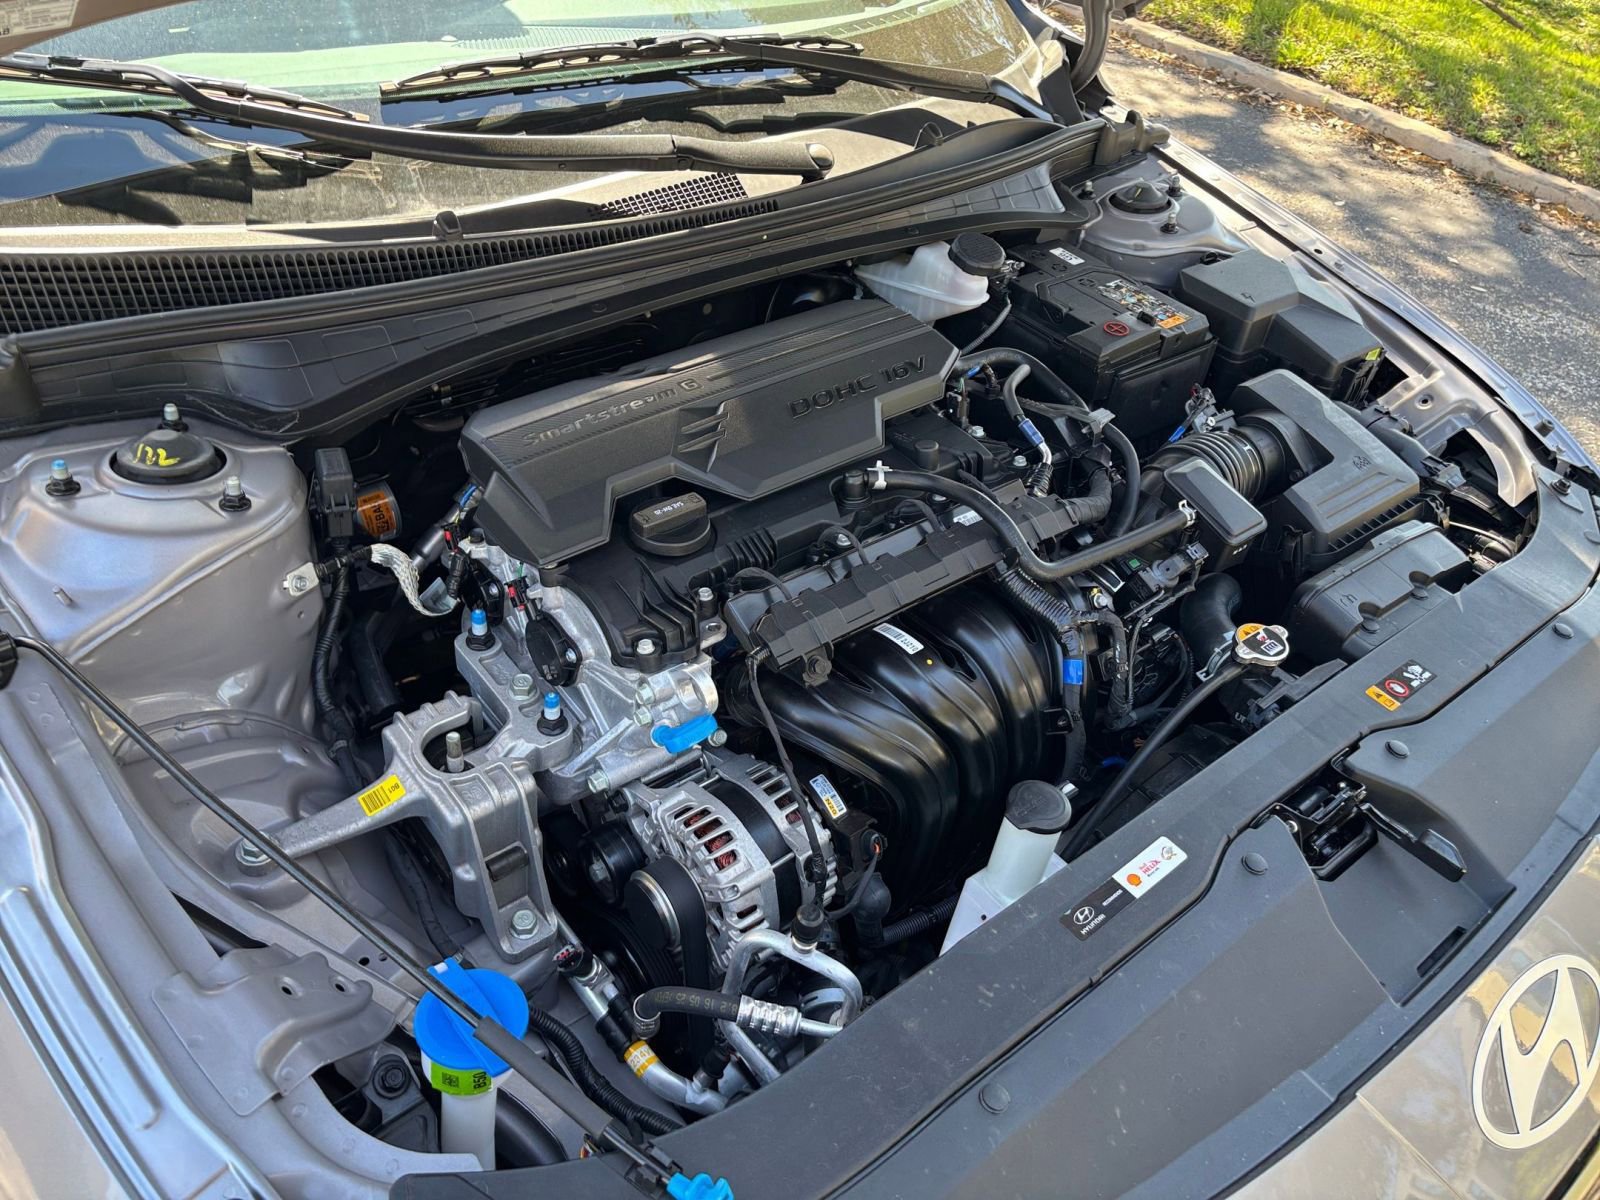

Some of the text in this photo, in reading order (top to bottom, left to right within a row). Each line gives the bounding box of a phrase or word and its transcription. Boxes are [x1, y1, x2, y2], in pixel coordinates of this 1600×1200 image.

[788, 355, 926, 418] DOHC 16V
[522, 379, 699, 446] Smartstream G
[387, 782, 400, 794] B01
[1080, 913, 1106, 935] HYUNDAI
